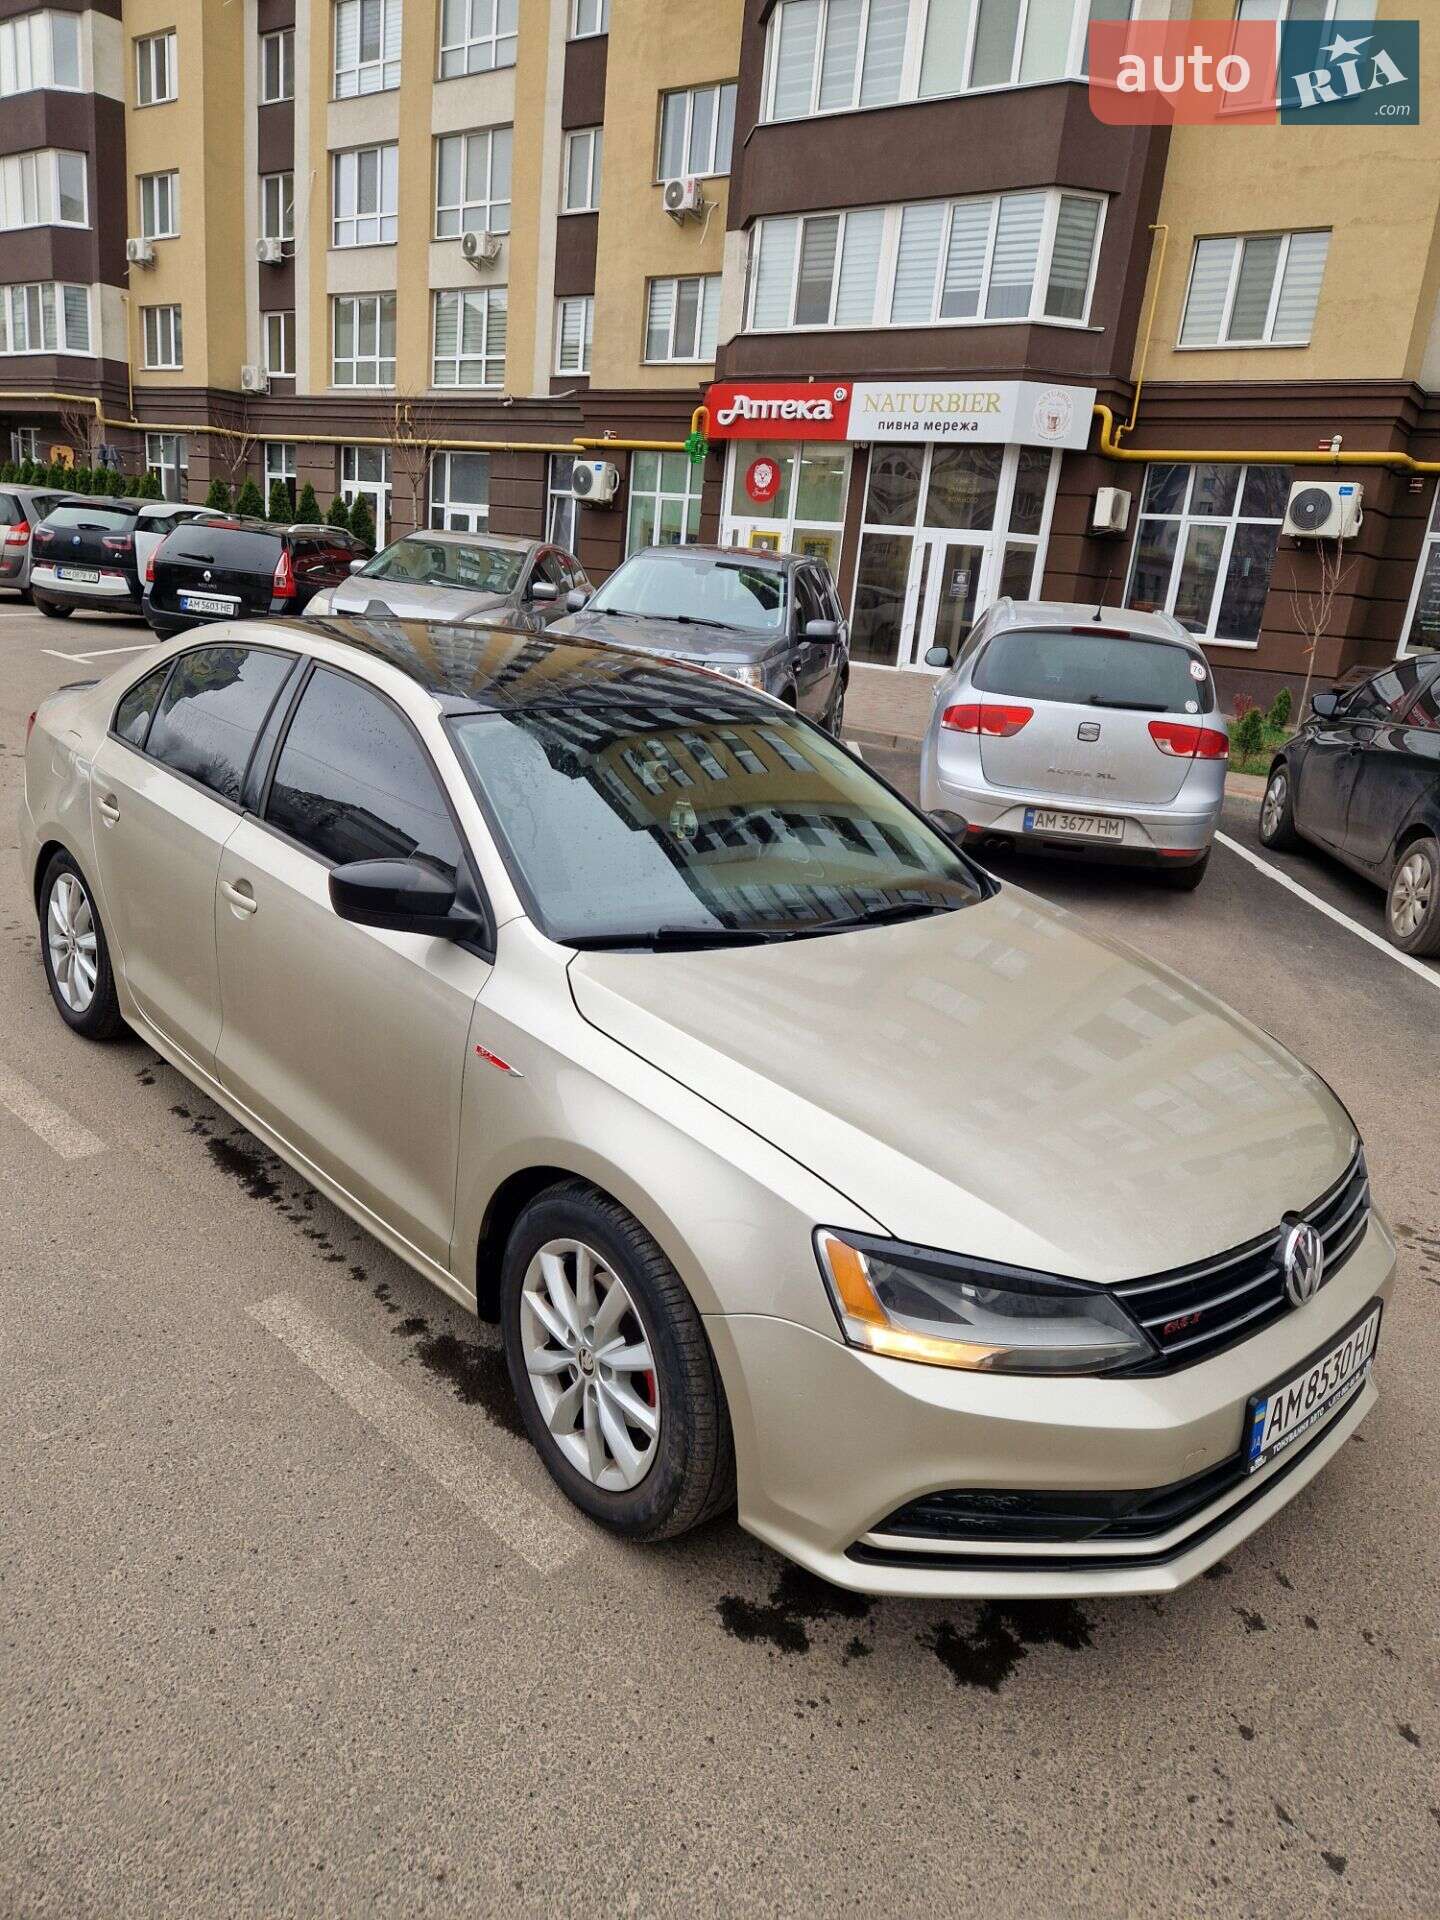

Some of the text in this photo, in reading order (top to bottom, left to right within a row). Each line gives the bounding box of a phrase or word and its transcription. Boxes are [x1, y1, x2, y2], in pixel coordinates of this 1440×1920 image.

[717, 395, 833, 426] Аптека
[862, 391, 1002, 413] NATURBIER
[878, 420, 979, 434] пивна мережа
[189, 599, 199, 609] AM
[221, 604, 233, 613] HE
[1035, 814, 1119, 835] AM 3677 HM
[1266, 1381, 1304, 1440] AM
[1305, 1341, 1352, 1410] 8530
[1352, 1317, 1374, 1368] HI
